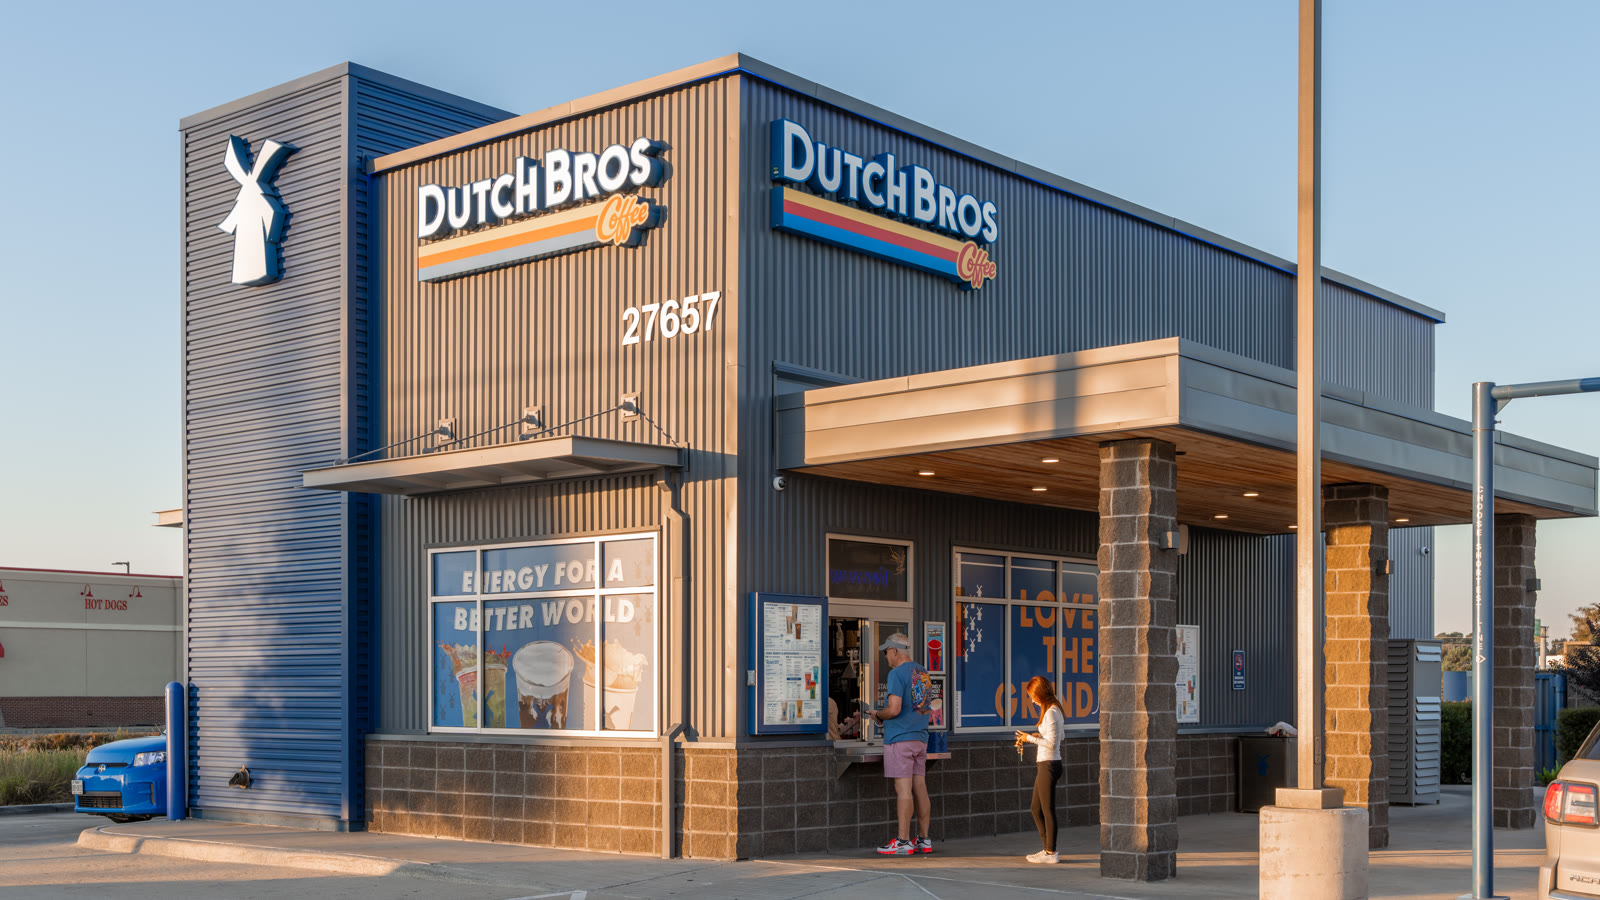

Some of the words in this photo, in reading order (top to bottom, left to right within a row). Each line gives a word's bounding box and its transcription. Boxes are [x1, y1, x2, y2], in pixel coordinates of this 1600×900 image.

[545, 137, 651, 209] BROS
[596, 193, 649, 245] Coffee
[913, 164, 999, 244] BROS
[957, 241, 997, 289] Coffee
[621, 290, 721, 346] 27657
[606, 557, 625, 582] A
[84, 598, 103, 610] HOT
[104, 599, 128, 611] DOGS
[453, 604, 535, 632] BETTER
[541, 598, 635, 627] WORLD
[1020, 589, 1094, 630] LOVE
[1042, 636, 1094, 674] THE
